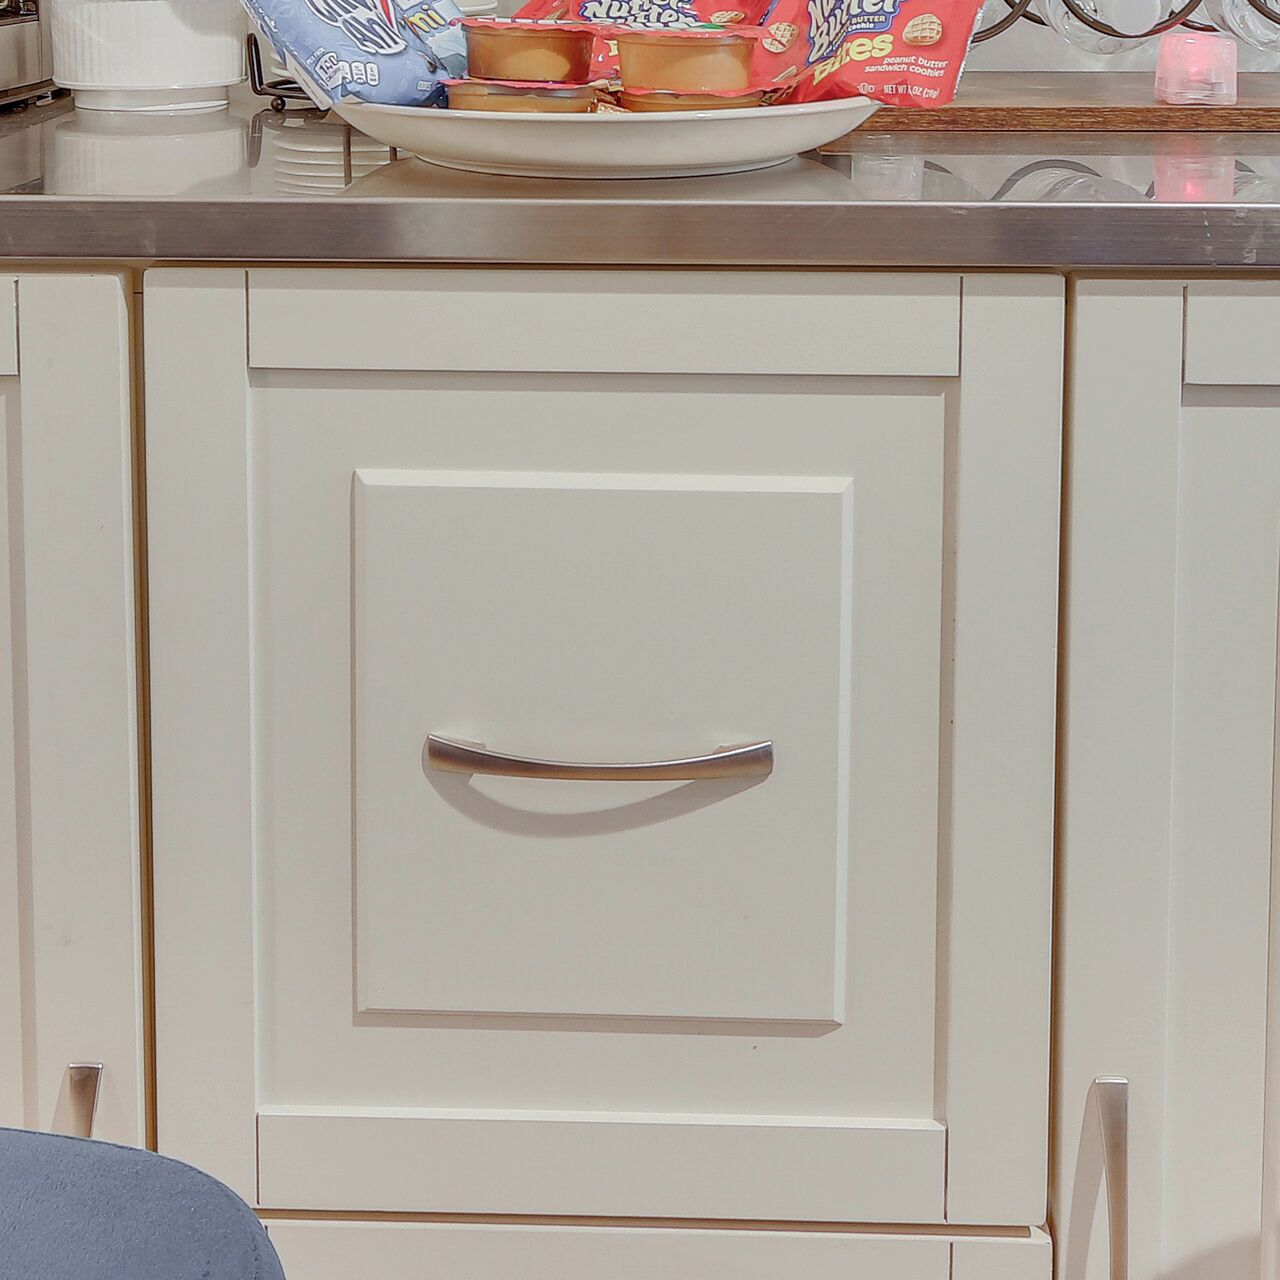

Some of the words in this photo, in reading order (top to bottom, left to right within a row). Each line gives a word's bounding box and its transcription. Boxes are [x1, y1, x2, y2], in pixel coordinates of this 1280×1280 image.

[848, 21, 875, 31] cookie
[883, 55, 917, 65] peanut
[918, 56, 948, 68] butter
[864, 63, 908, 73] sandwich
[909, 65, 945, 77] cookies
[883, 84, 897, 94] NET
